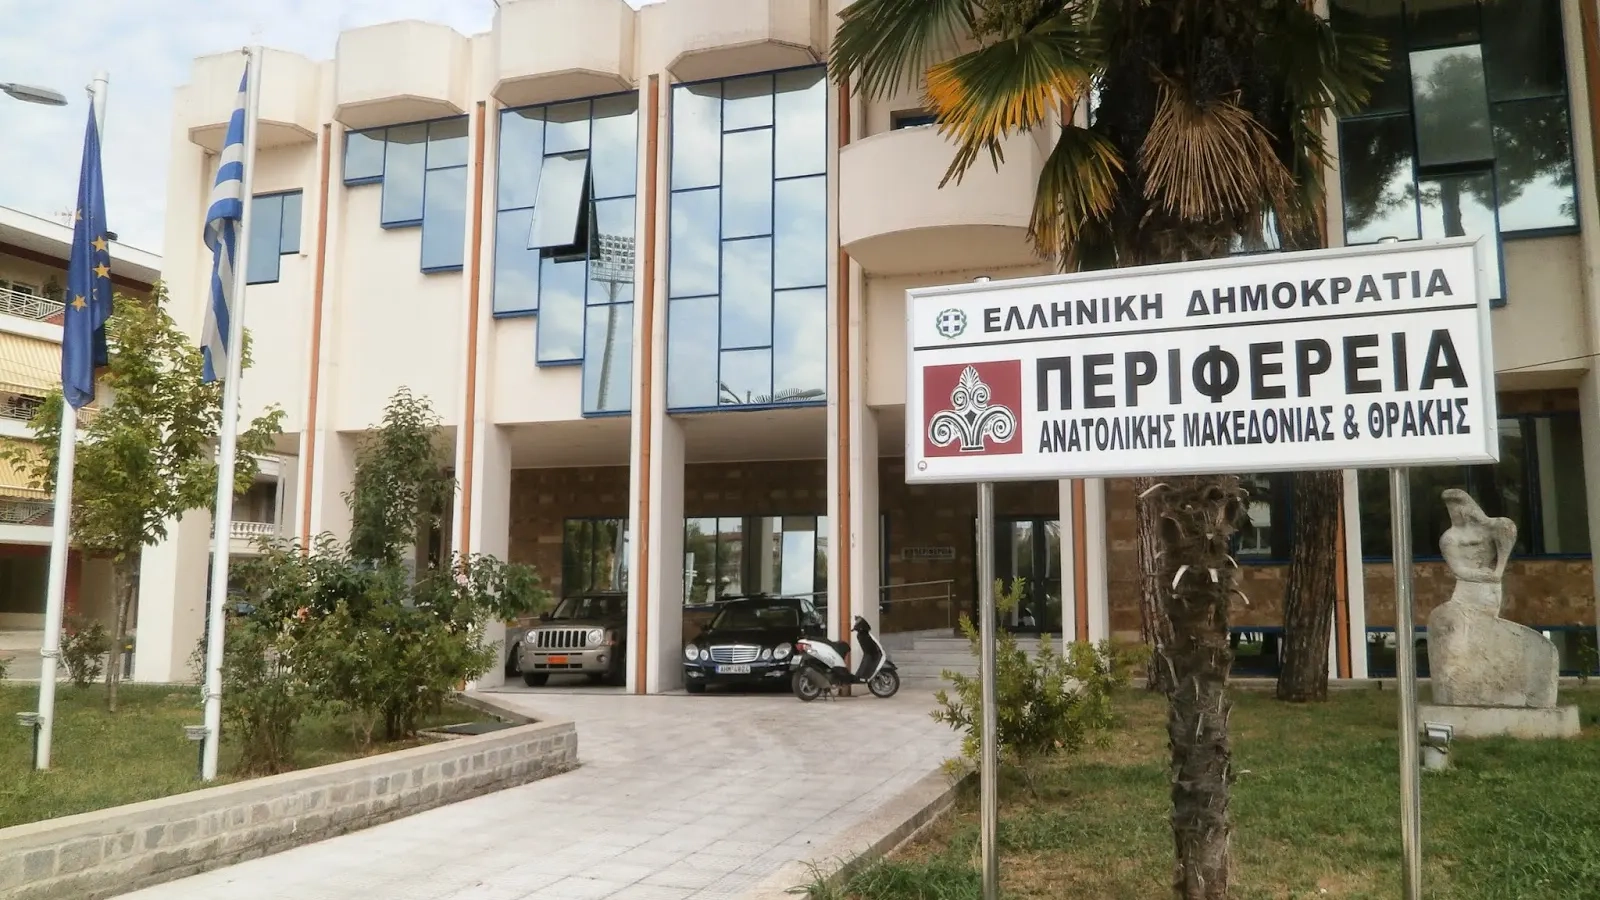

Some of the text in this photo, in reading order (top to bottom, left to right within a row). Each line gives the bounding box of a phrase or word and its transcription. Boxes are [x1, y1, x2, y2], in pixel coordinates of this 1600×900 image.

[985, 269, 1453, 333] ΕΛΛΗΝΙΚΗ ΔΗΜΟΚΡΑΤΙΑ
[1037, 329, 1469, 411] ΠΕΡΙΦΕΡΕΙΑ
[1040, 398, 1471, 453] ΑΝΑΤΟΛΙΚΗΣ ΜΑΚΕΔΟΝΙΑΣ & ΘΡΑΚΗΣ
